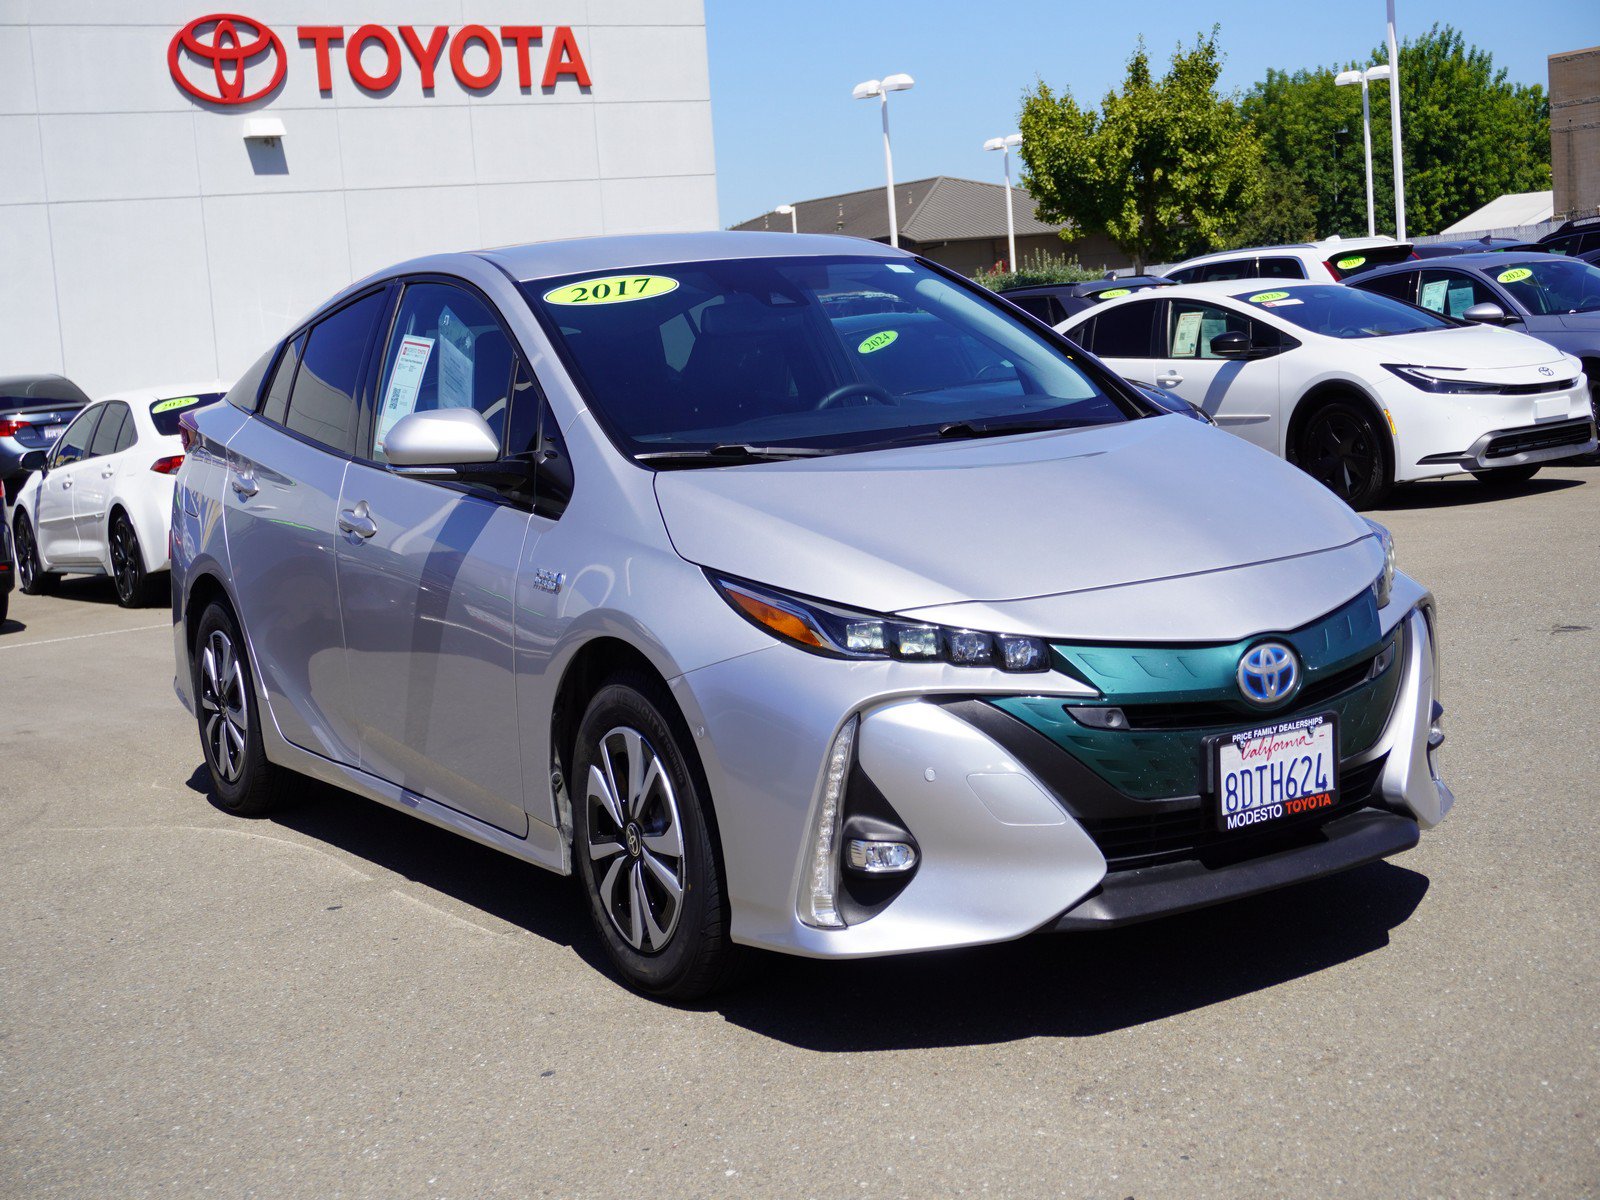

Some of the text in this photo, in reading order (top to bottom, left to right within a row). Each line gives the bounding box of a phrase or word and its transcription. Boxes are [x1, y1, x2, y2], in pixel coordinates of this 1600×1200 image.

[297, 24, 592, 91] TOYOTA
[1503, 269, 1526, 281] 2023
[571, 278, 650, 302] 2017
[864, 333, 890, 350] 2024
[1232, 716, 1323, 743] PRICE FAMILY DEALERSHIPS
[1242, 736, 1313, 761] California
[1225, 752, 1328, 813] 8DTH624
[1227, 793, 1331, 829] MODESTO TOYOTA
